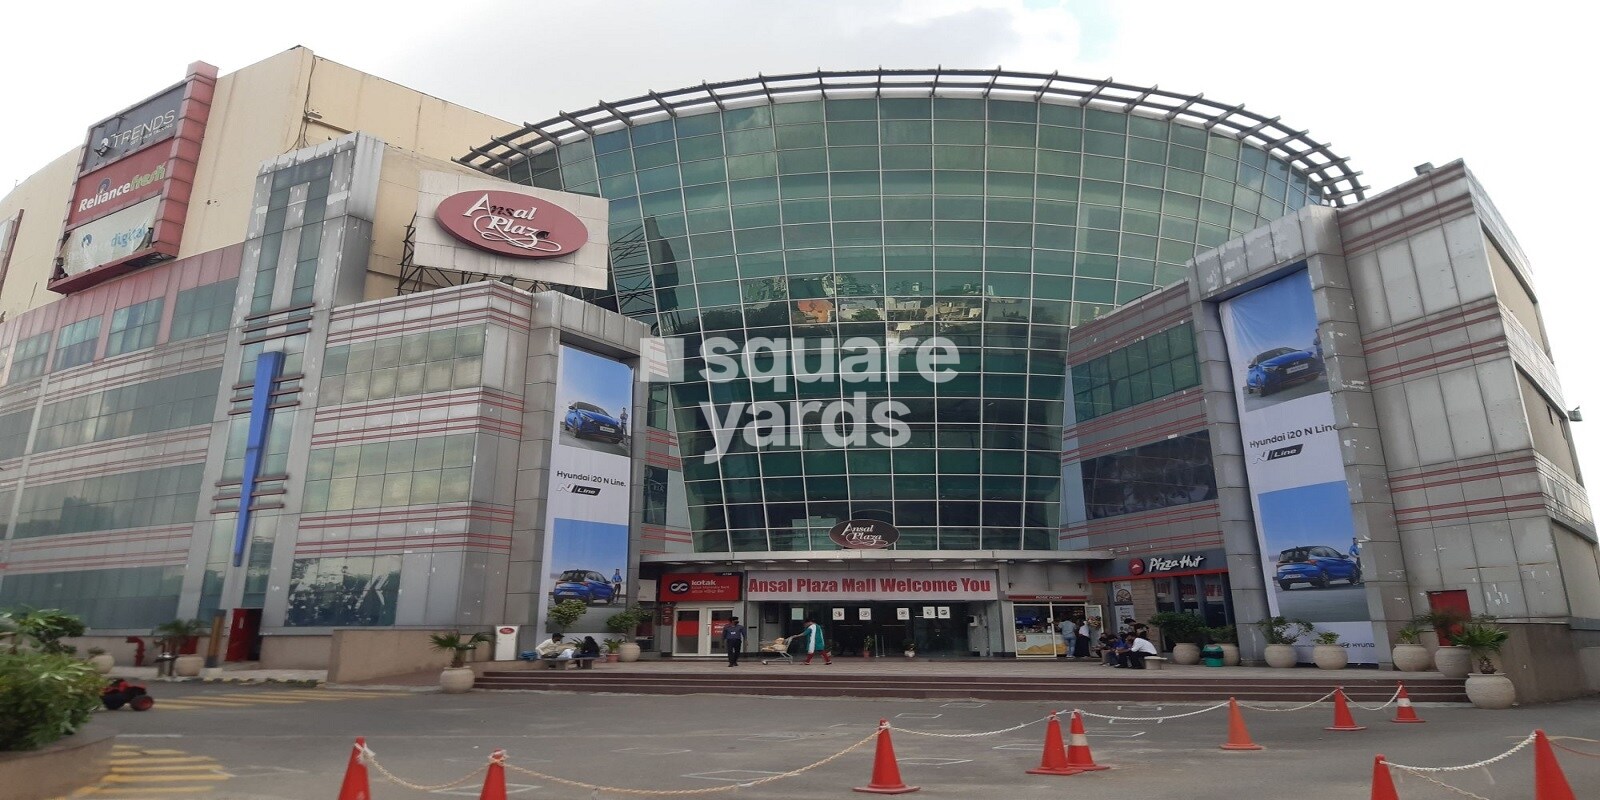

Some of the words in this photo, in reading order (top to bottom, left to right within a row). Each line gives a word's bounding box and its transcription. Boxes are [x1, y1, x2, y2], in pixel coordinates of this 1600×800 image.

[110, 109, 175, 148] TRENDS
[462, 193, 537, 220] Ansal
[474, 215, 550, 249] Plaza
[1249, 433, 1285, 448] Hyundai
[1287, 430, 1302, 440] i20
[1304, 427, 1313, 436] N
[1274, 448, 1297, 458] Line
[556, 470, 590, 481] Hyundai
[591, 475, 602, 483] i20
[577, 486, 596, 494] Line
[842, 523, 874, 536] Ansal
[846, 531, 883, 546] Plaza
[1148, 557, 1179, 572] Pizza
[1179, 555, 1204, 568] Hut
[748, 578, 793, 593] Ansal
[796, 578, 838, 593] Plaza
[841, 578, 876, 593] Mall
[879, 578, 957, 593] Welcome
[960, 577, 991, 592] You
